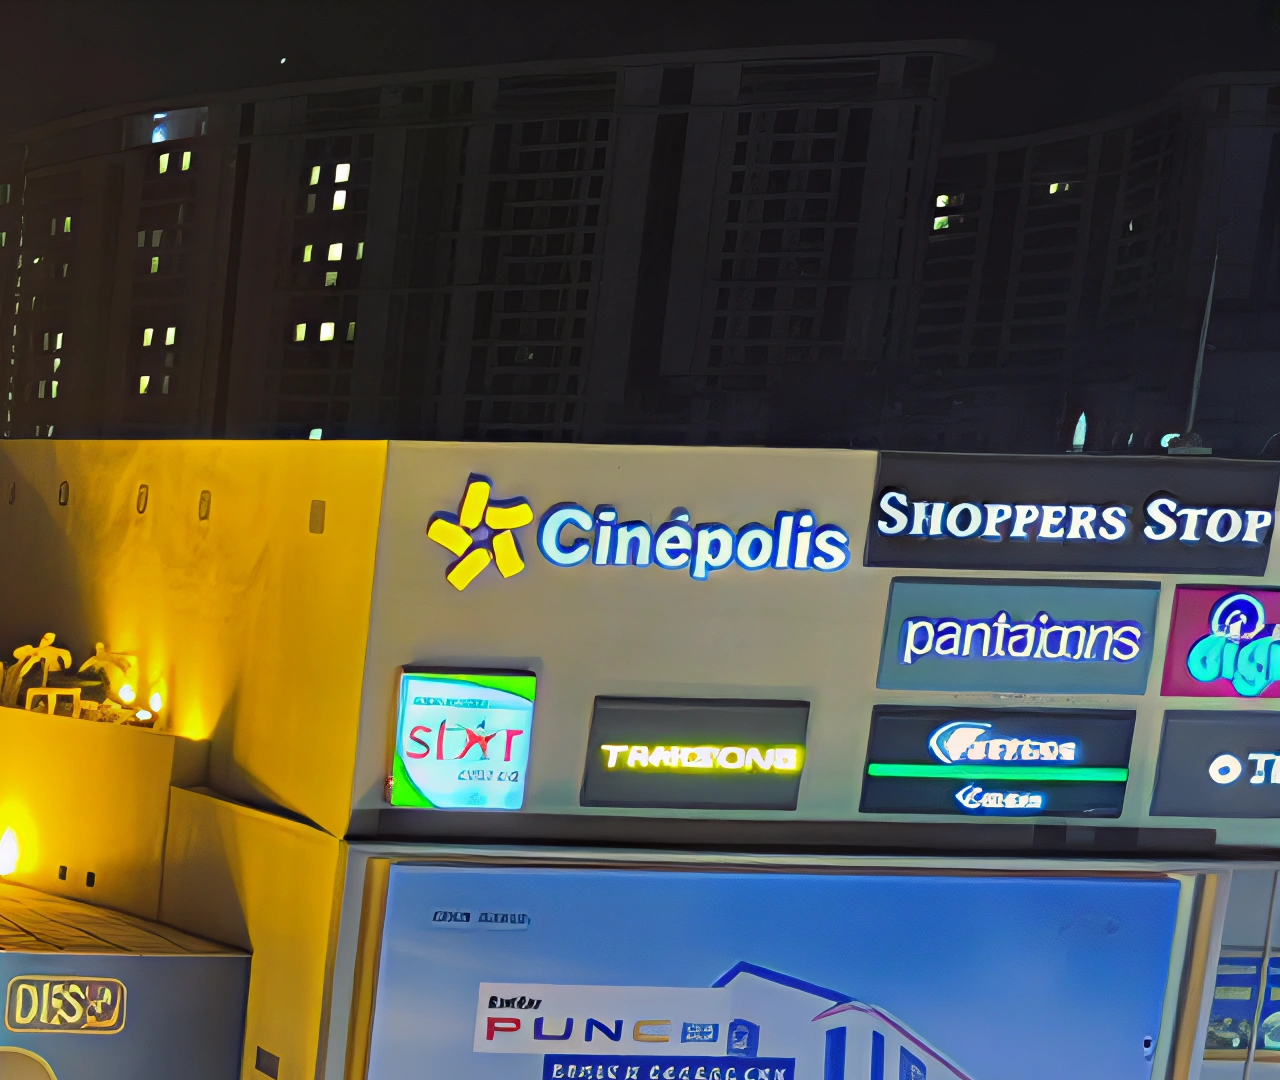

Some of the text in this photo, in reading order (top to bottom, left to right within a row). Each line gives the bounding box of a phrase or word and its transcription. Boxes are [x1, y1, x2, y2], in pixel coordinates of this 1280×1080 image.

[538, 500, 851, 581] Cinépolis
[877, 490, 1273, 544] SHOPPERS STOP
